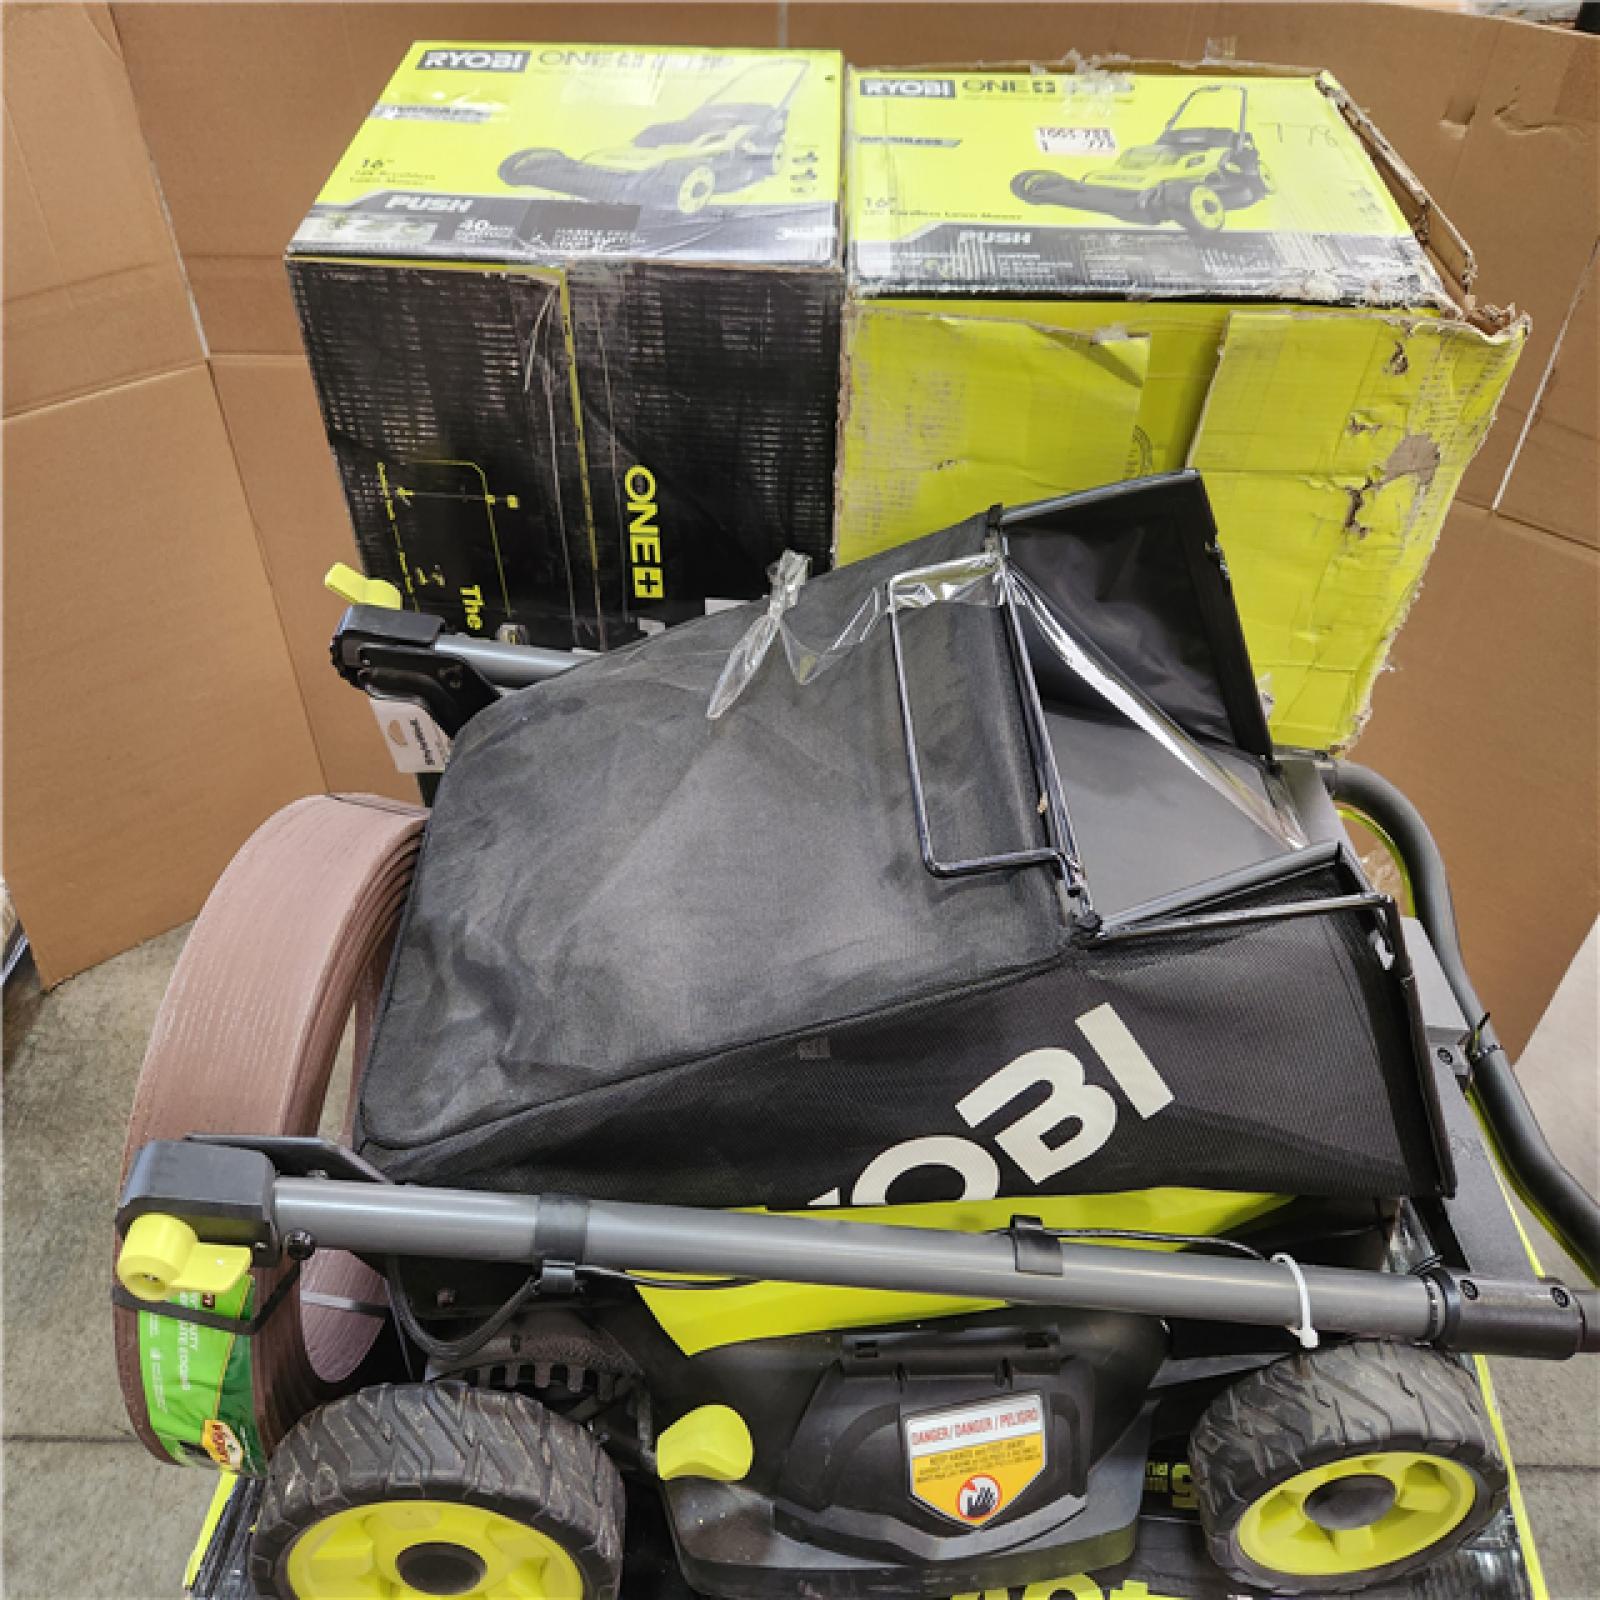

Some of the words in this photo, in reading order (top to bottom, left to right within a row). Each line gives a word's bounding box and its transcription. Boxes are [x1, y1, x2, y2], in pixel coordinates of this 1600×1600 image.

[424, 51, 525, 69] RYOBI
[864, 80, 949, 97] RYOBI
[385, 194, 473, 213] PUSH
[460, 584, 485, 630] The
[808, 1002, 1176, 1206] OBI
